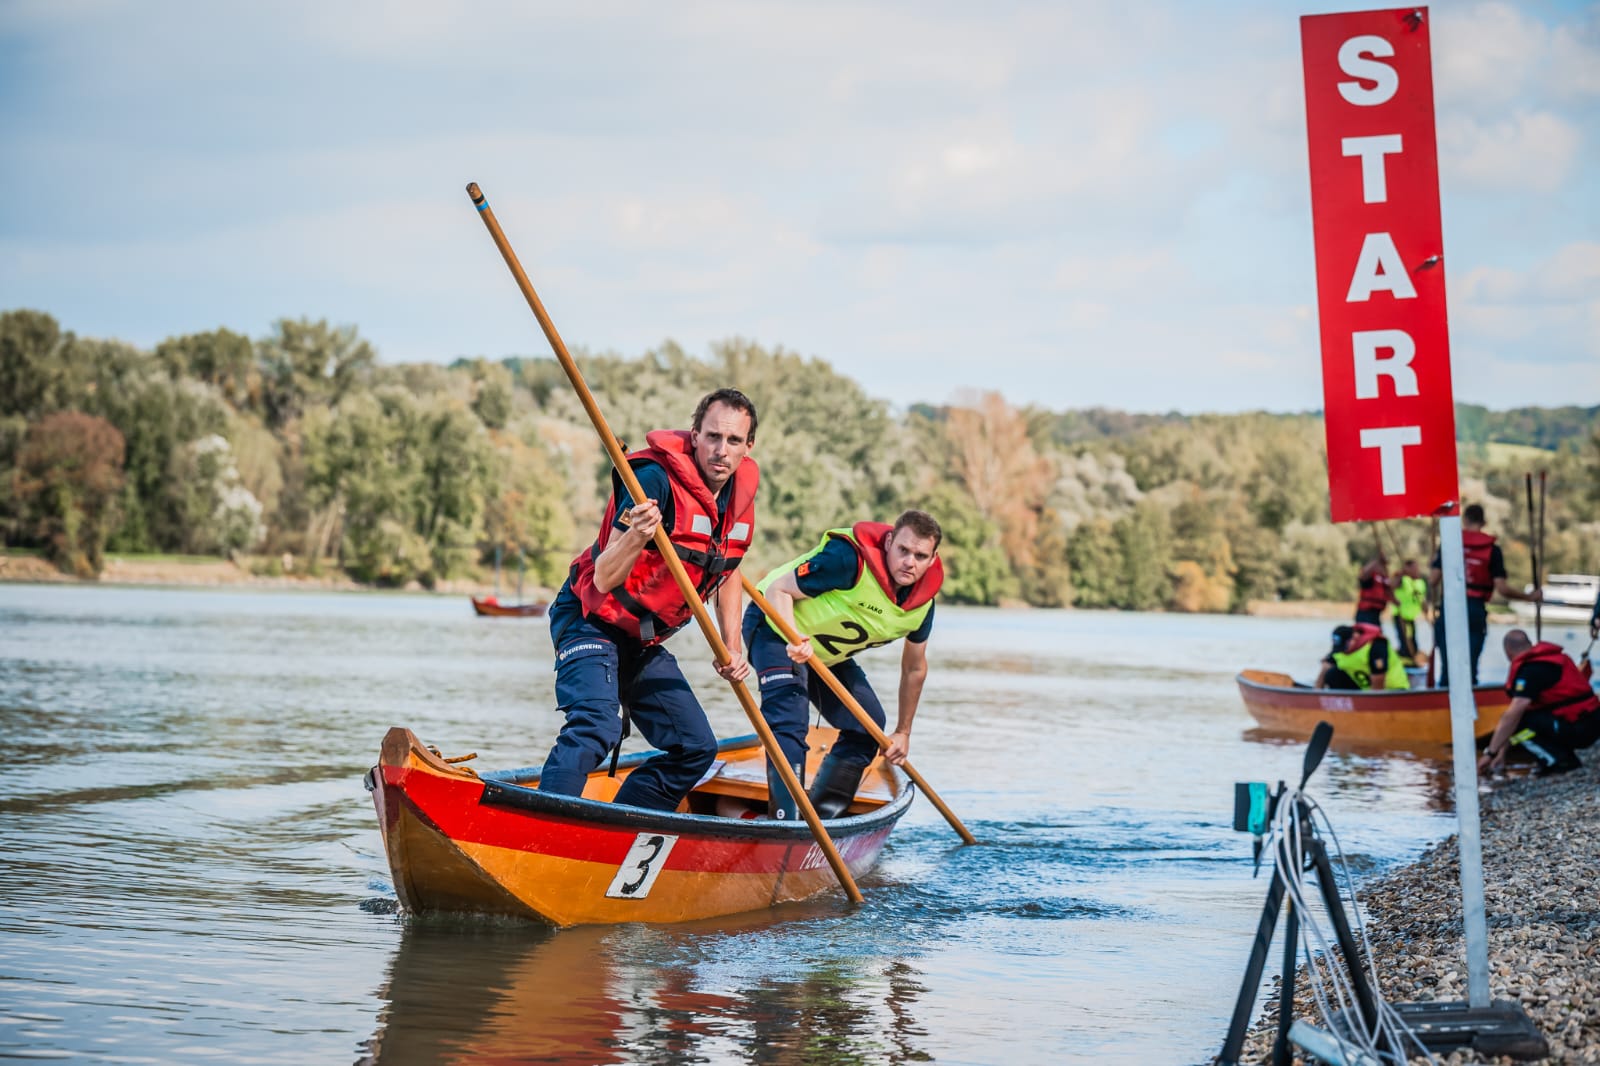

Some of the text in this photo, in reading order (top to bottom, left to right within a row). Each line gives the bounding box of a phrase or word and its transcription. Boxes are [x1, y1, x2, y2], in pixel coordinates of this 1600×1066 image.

[1337, 35, 1422, 496] START
[867, 604, 883, 615] JAKO
[620, 836, 664, 895] 3
